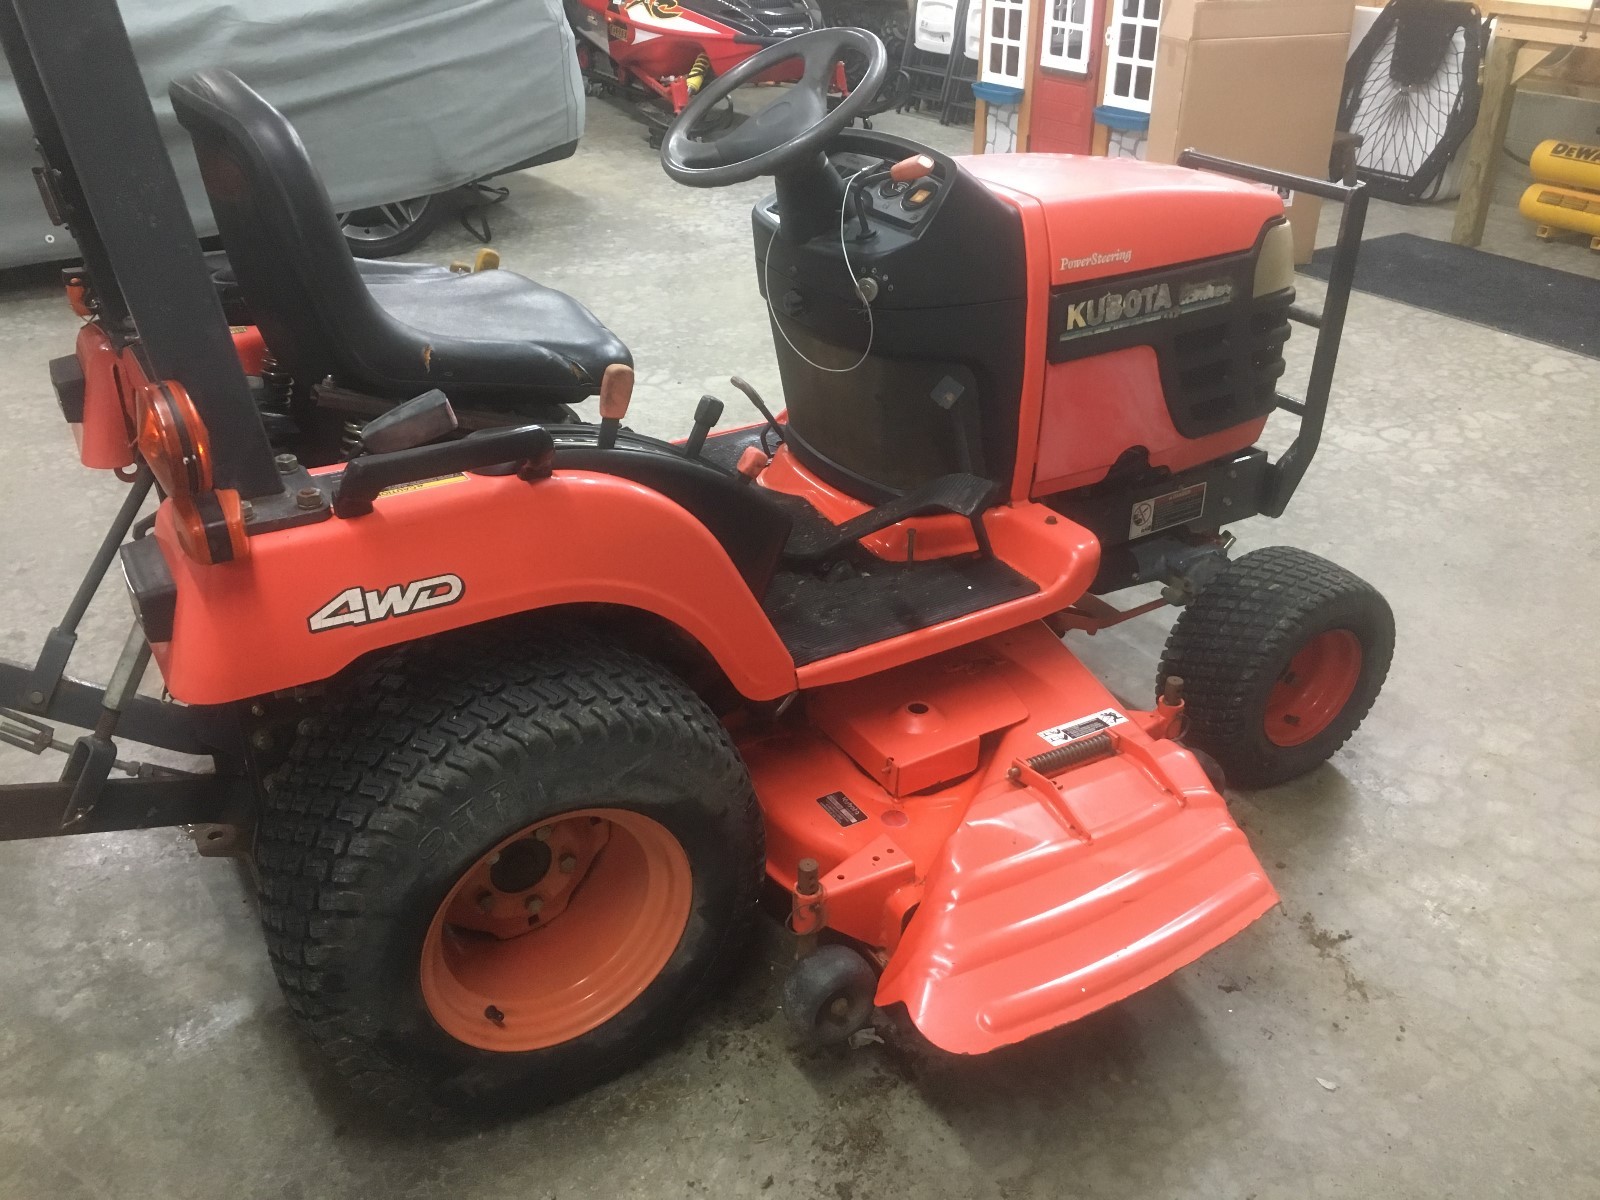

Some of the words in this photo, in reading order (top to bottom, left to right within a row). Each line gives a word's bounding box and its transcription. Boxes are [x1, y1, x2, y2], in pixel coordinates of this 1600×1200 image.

[1060, 249, 1132, 271] PowerSteering
[1067, 283, 1173, 330] KUBOTA
[308, 573, 465, 634] 4WD
